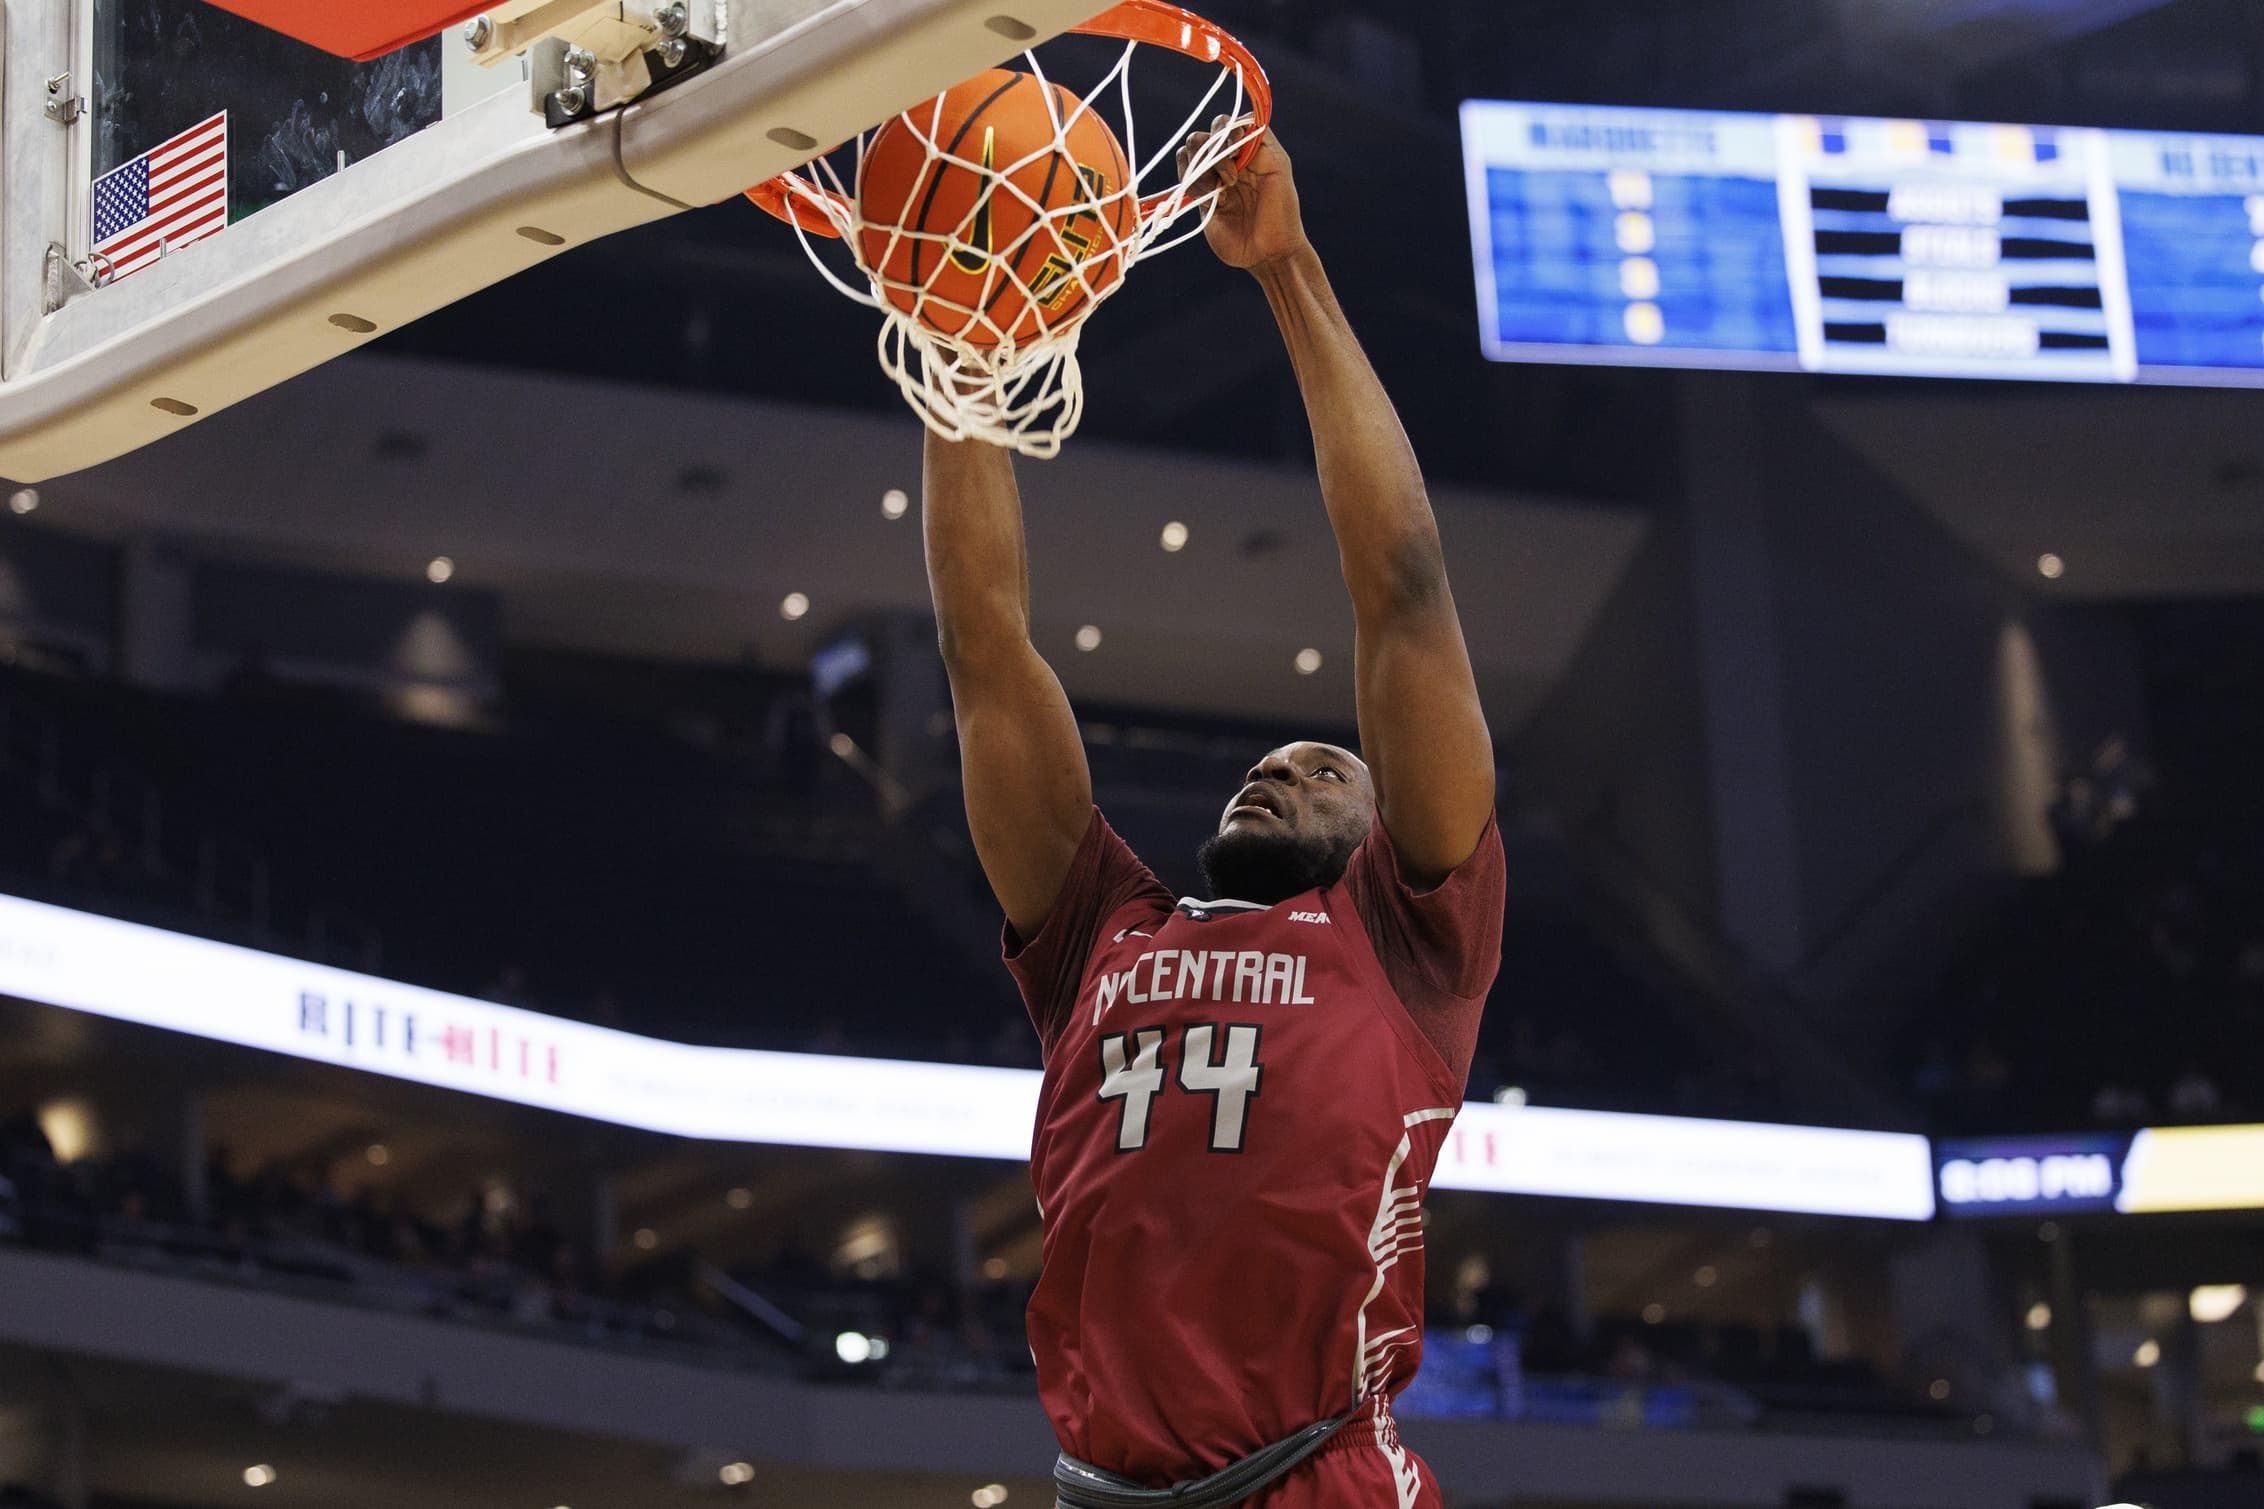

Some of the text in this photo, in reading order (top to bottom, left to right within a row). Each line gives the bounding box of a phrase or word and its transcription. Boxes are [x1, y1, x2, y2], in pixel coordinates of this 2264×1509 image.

[1021, 162, 1105, 307] ELITE
[1127, 949, 1314, 1005] CENTRAL
[1097, 1022, 1264, 1154] 44
